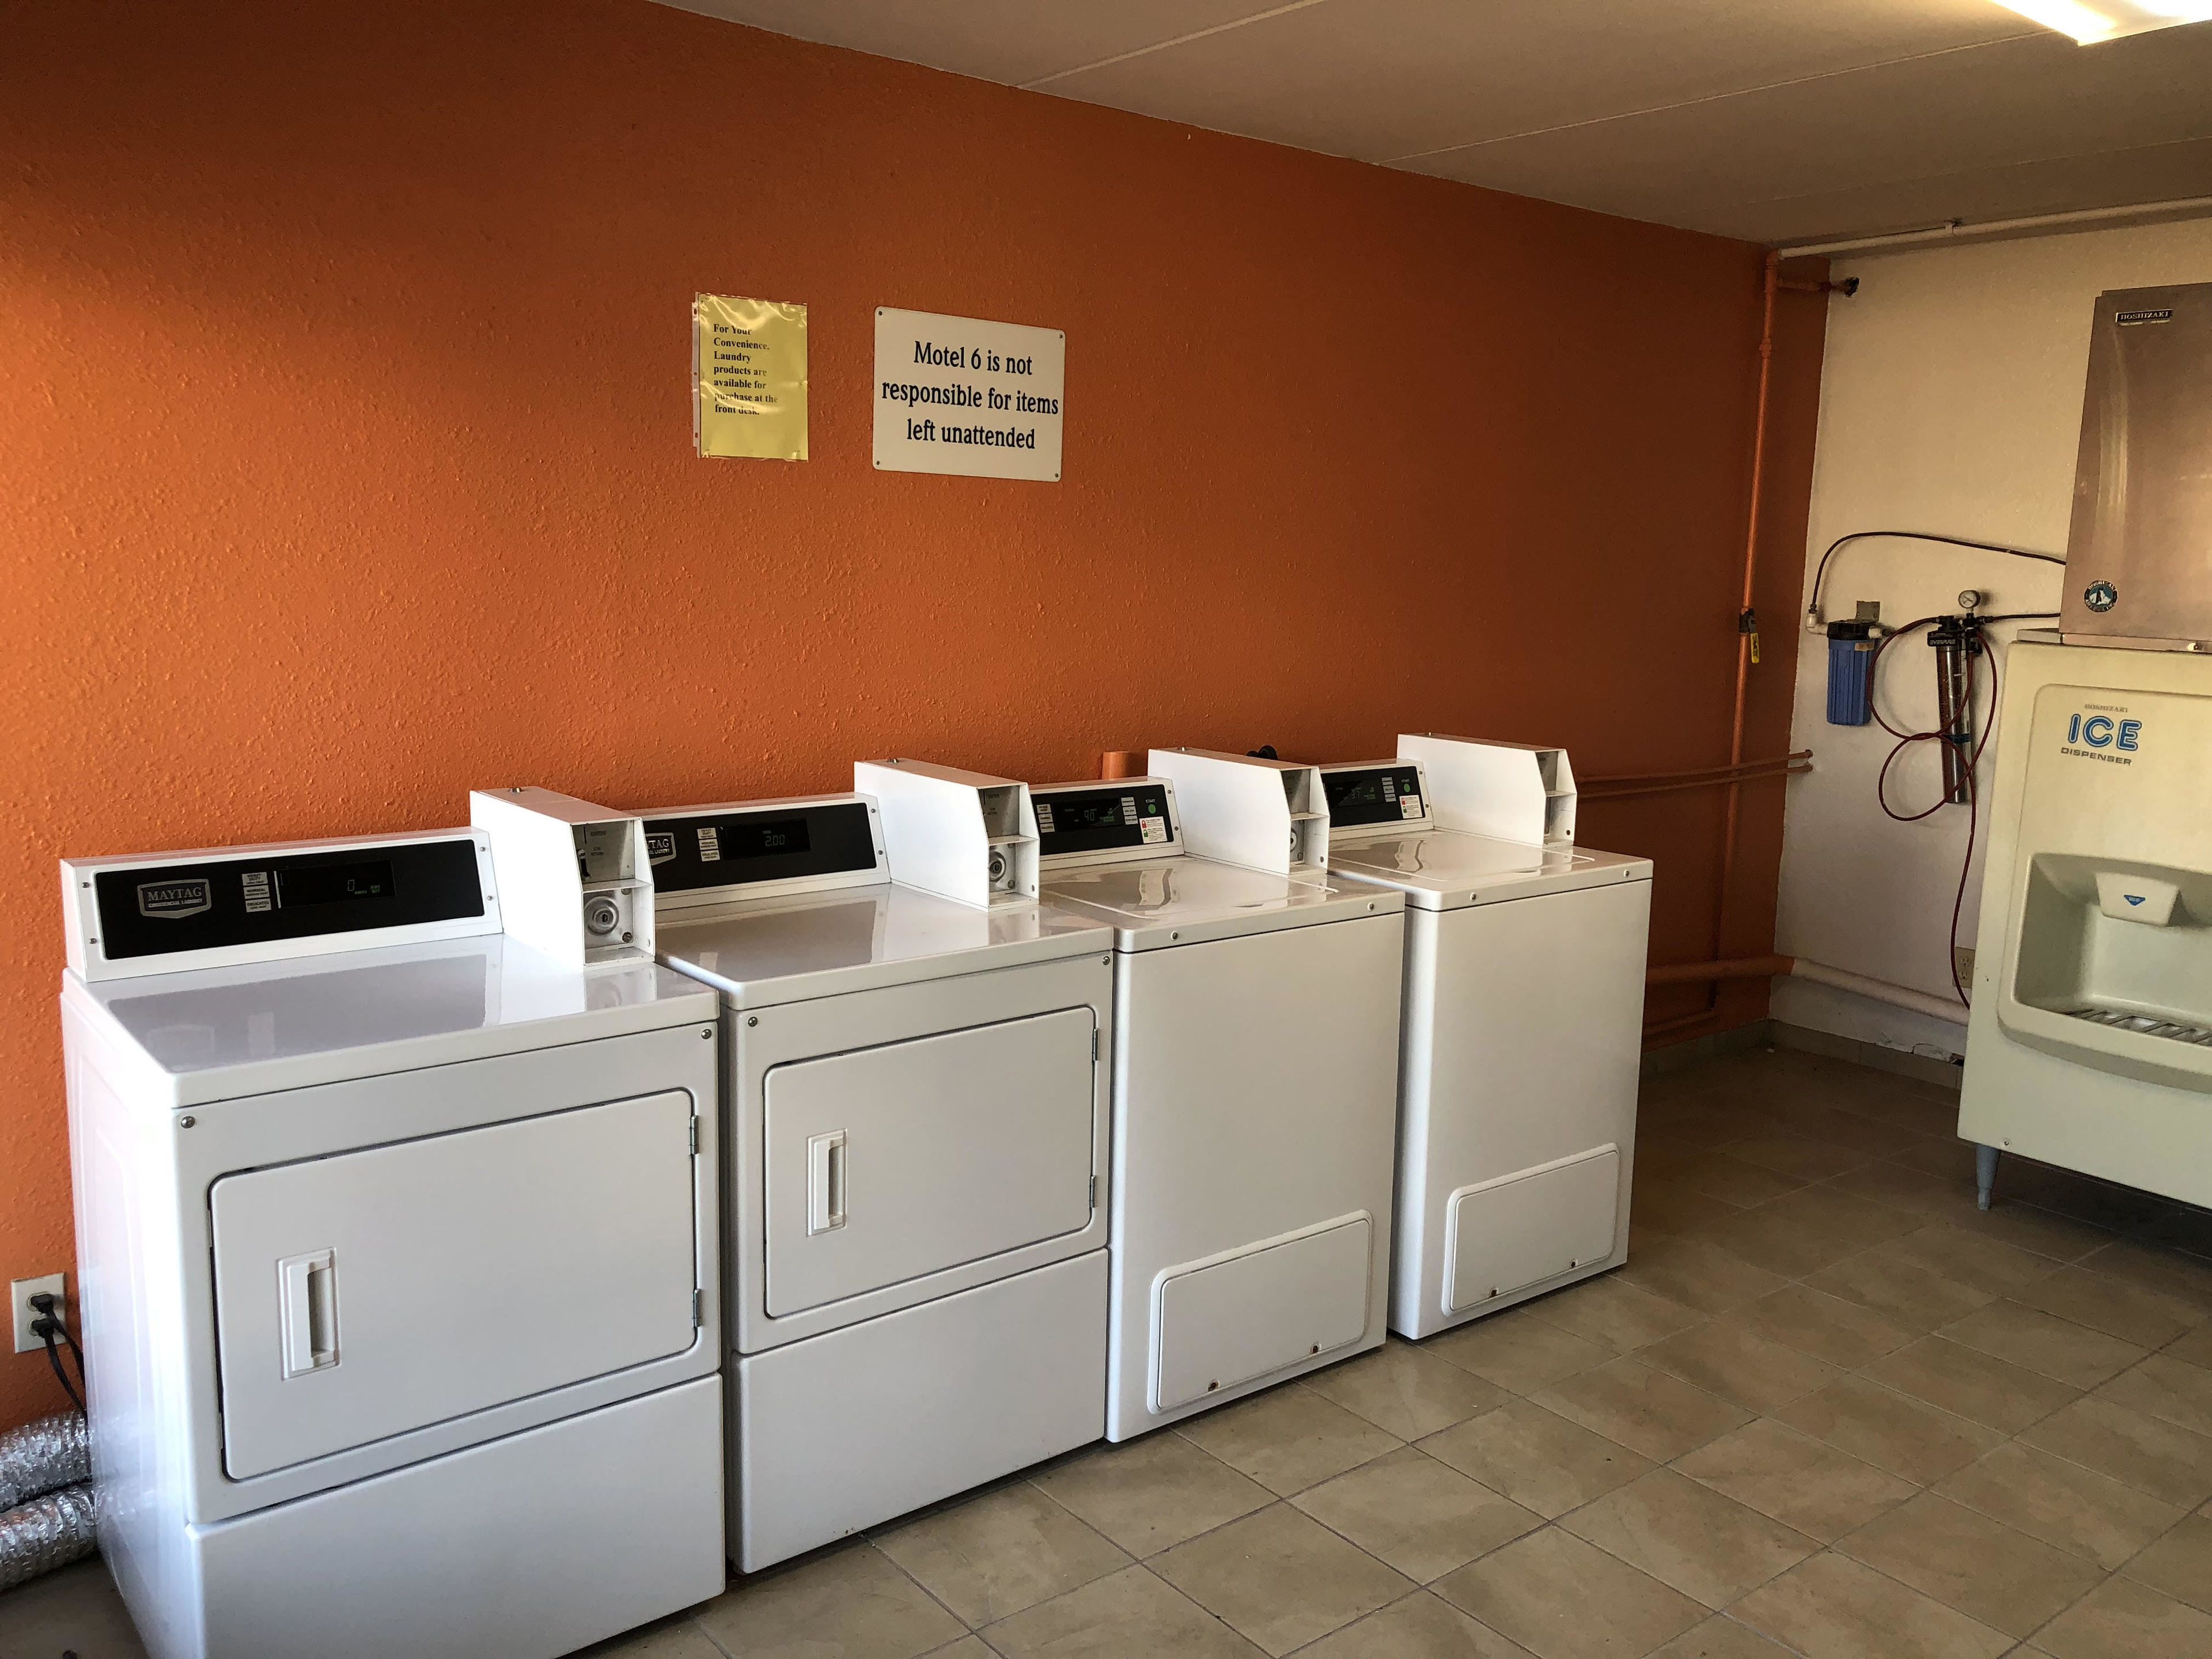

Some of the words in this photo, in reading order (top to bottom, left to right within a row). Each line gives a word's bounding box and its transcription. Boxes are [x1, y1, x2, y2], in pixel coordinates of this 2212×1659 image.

[2120, 311, 2169, 320] HOSHIZAKI
[713, 323, 729, 333] For
[731, 325, 752, 335] Your
[714, 350, 751, 364] Laundry
[914, 340, 965, 368] Motel
[971, 348, 982, 369] 6
[987, 350, 1000, 372] is
[1005, 356, 1033, 376] not
[714, 365, 751, 376] products
[714, 379, 752, 388] available
[754, 380, 767, 389] for
[714, 392, 752, 402] purchase
[765, 394, 778, 403] the
[881, 381, 982, 407] responsible
[988, 387, 1012, 410] for
[1016, 390, 1059, 415] items
[715, 404, 736, 413] front
[907, 418, 935, 441] left
[941, 425, 1036, 449] unattended
[2067, 713, 2142, 751] ICE
[2061, 747, 2132, 766] DISPENSER
[647, 839, 669, 850] TAG
[147, 887, 202, 902] MAYTAG
